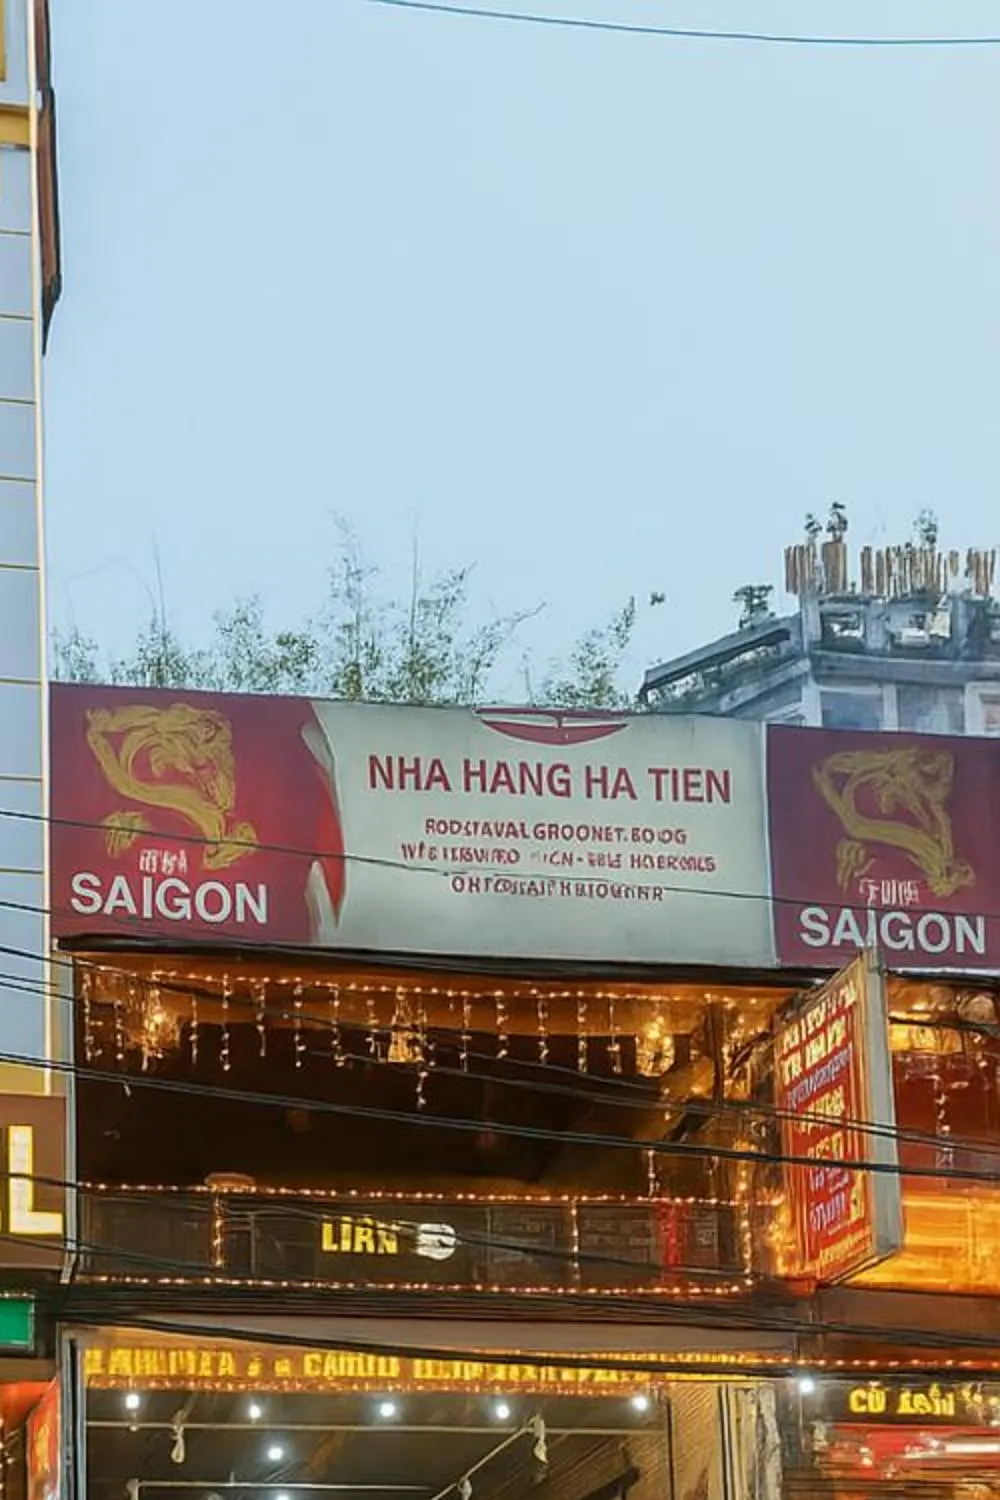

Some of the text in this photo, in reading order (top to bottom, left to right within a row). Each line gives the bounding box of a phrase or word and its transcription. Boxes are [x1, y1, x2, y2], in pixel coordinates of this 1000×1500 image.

[370, 755, 732, 804] NHA HANG HA TIEN
[71, 873, 269, 925] SAIGON
[800, 906, 987, 955] SAIGON
